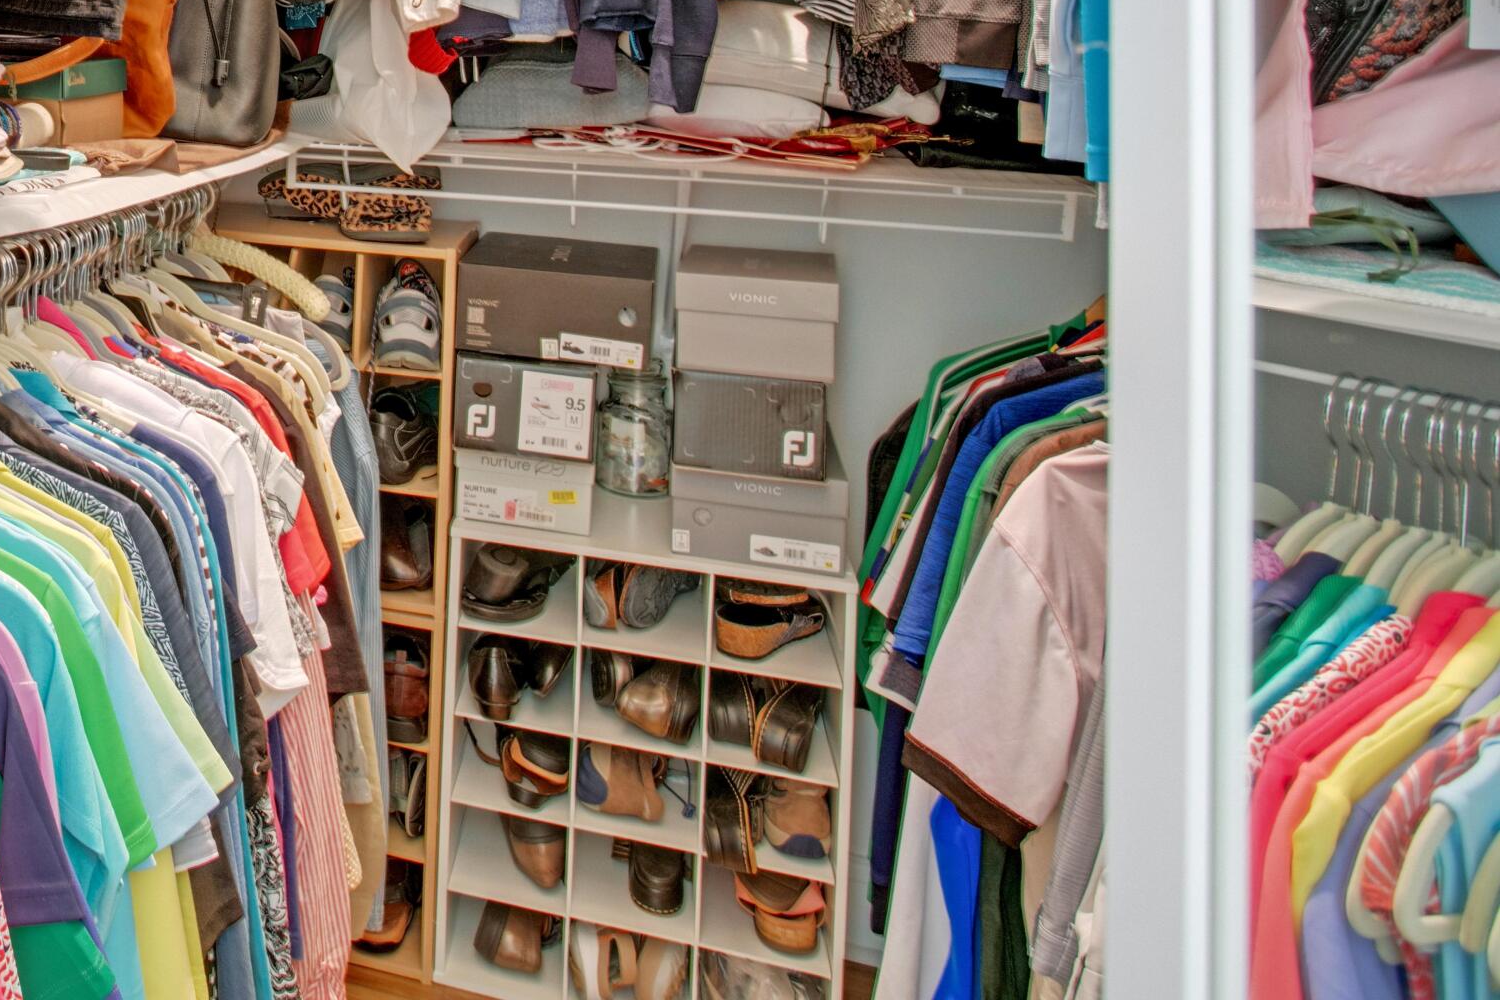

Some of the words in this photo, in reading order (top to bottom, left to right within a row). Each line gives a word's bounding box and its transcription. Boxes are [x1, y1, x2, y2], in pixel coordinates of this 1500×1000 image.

[467, 298, 499, 308] VIONIC
[729, 292, 778, 305] VIONIC
[565, 397, 586, 412] 9.5
[466, 404, 496, 438] FJ
[570, 415, 579, 425] M
[783, 430, 816, 467] FJ
[480, 455, 532, 472] nurture
[463, 483, 498, 495] NURTURE
[733, 481, 783, 496] VIONIC
